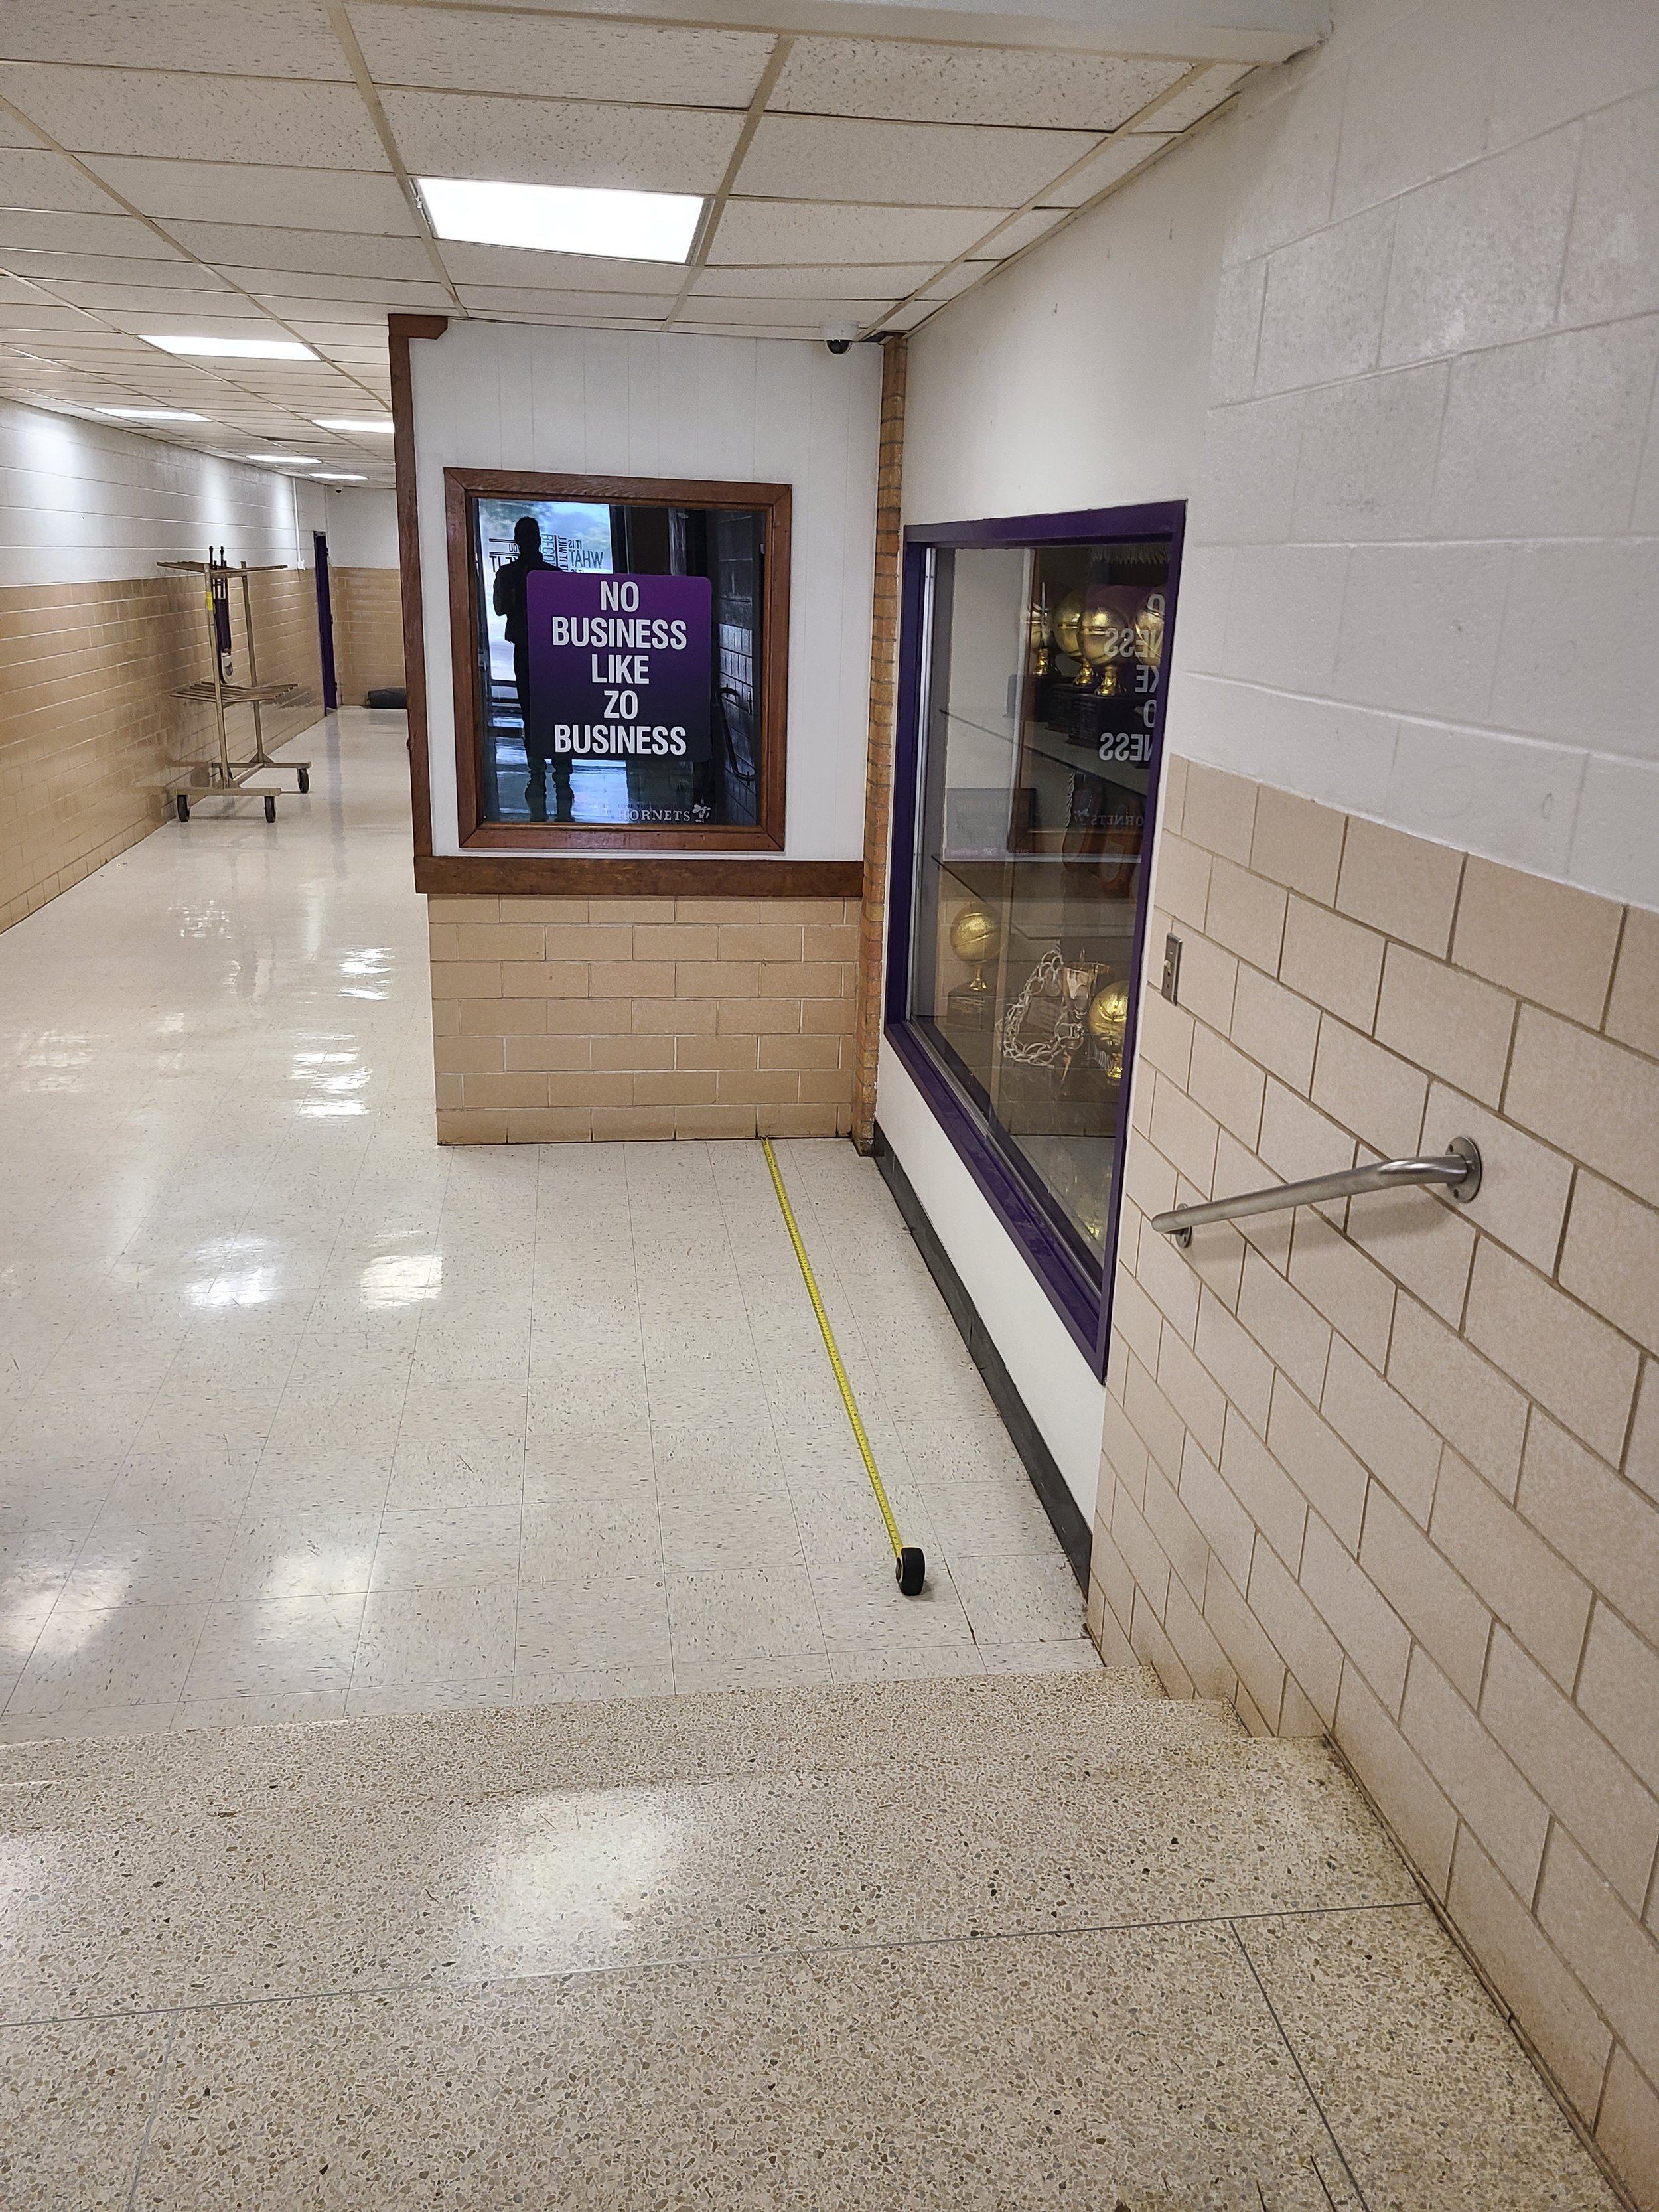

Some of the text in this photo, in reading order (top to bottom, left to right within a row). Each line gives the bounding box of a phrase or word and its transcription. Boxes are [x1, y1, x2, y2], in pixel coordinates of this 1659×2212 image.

[600, 581, 640, 612] NO
[552, 616, 687, 650] BUSINESS
[591, 654, 650, 684] LIKE
[603, 690, 638, 719] ZO
[554, 724, 687, 755] BUSINESS
[618, 809, 691, 822] HORNETS
